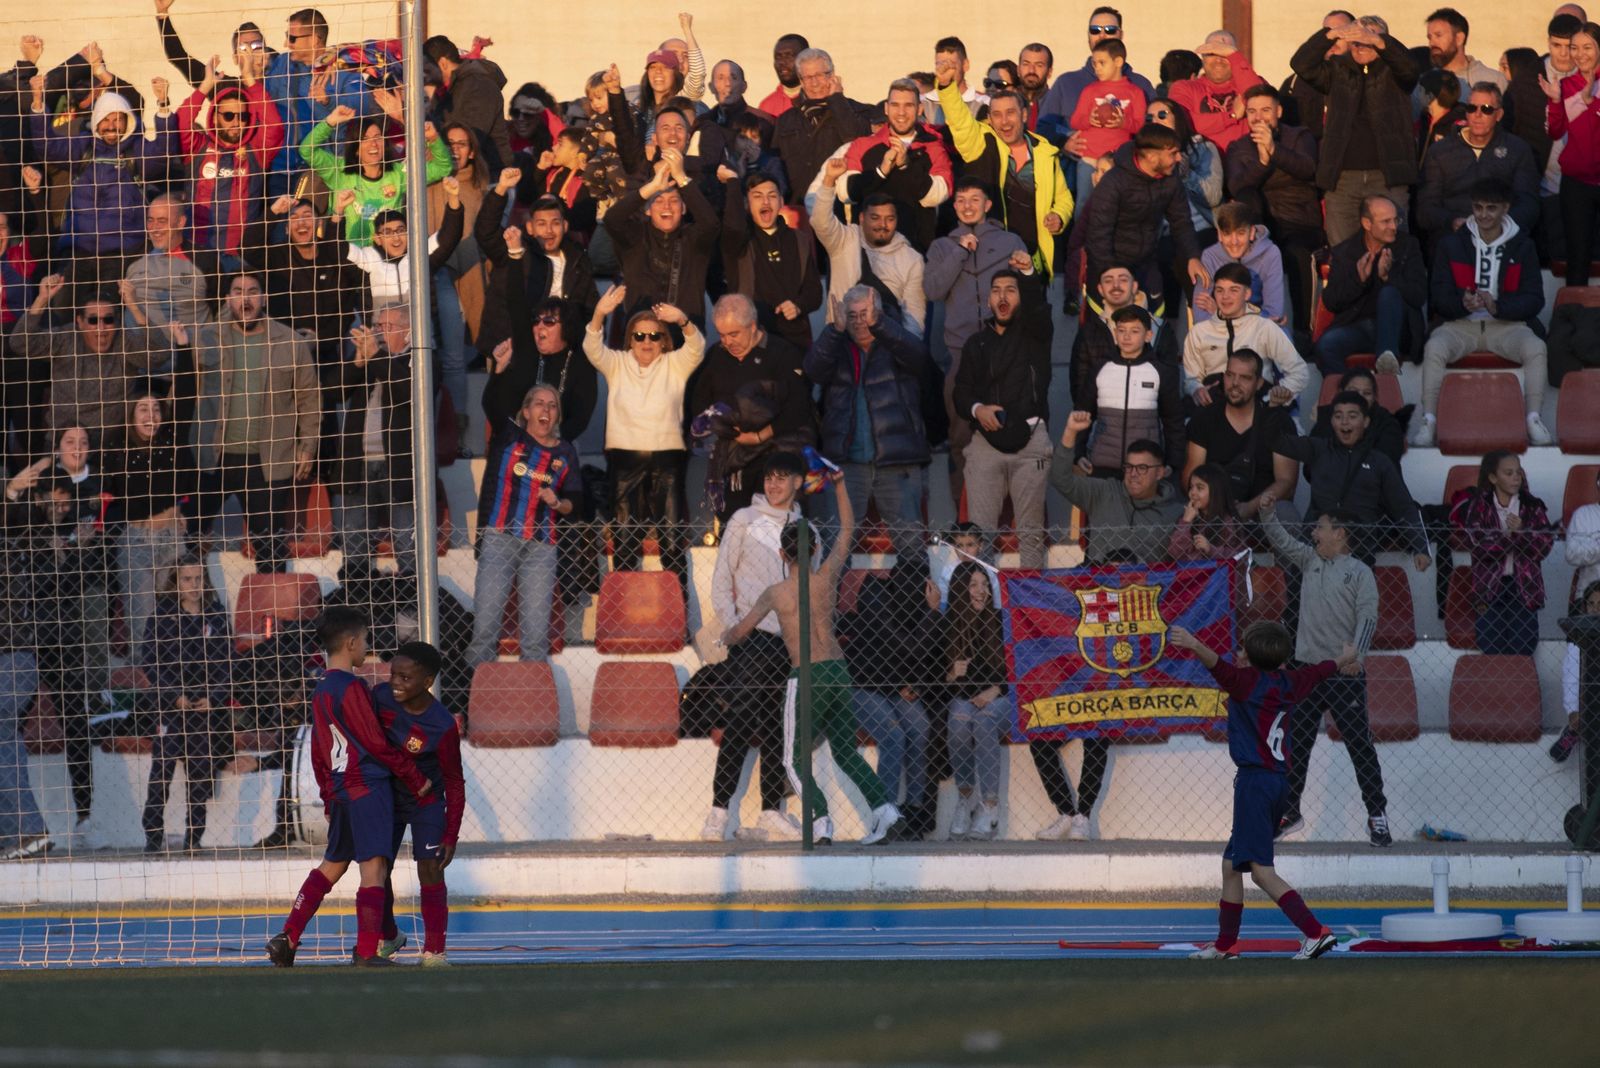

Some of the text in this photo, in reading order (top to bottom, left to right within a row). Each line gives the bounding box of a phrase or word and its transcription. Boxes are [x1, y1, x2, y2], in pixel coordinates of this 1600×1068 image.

[1056, 694, 1198, 717] FORÇA BARÇA
[329, 723, 349, 773] 4
[1266, 711, 1287, 761] 6
